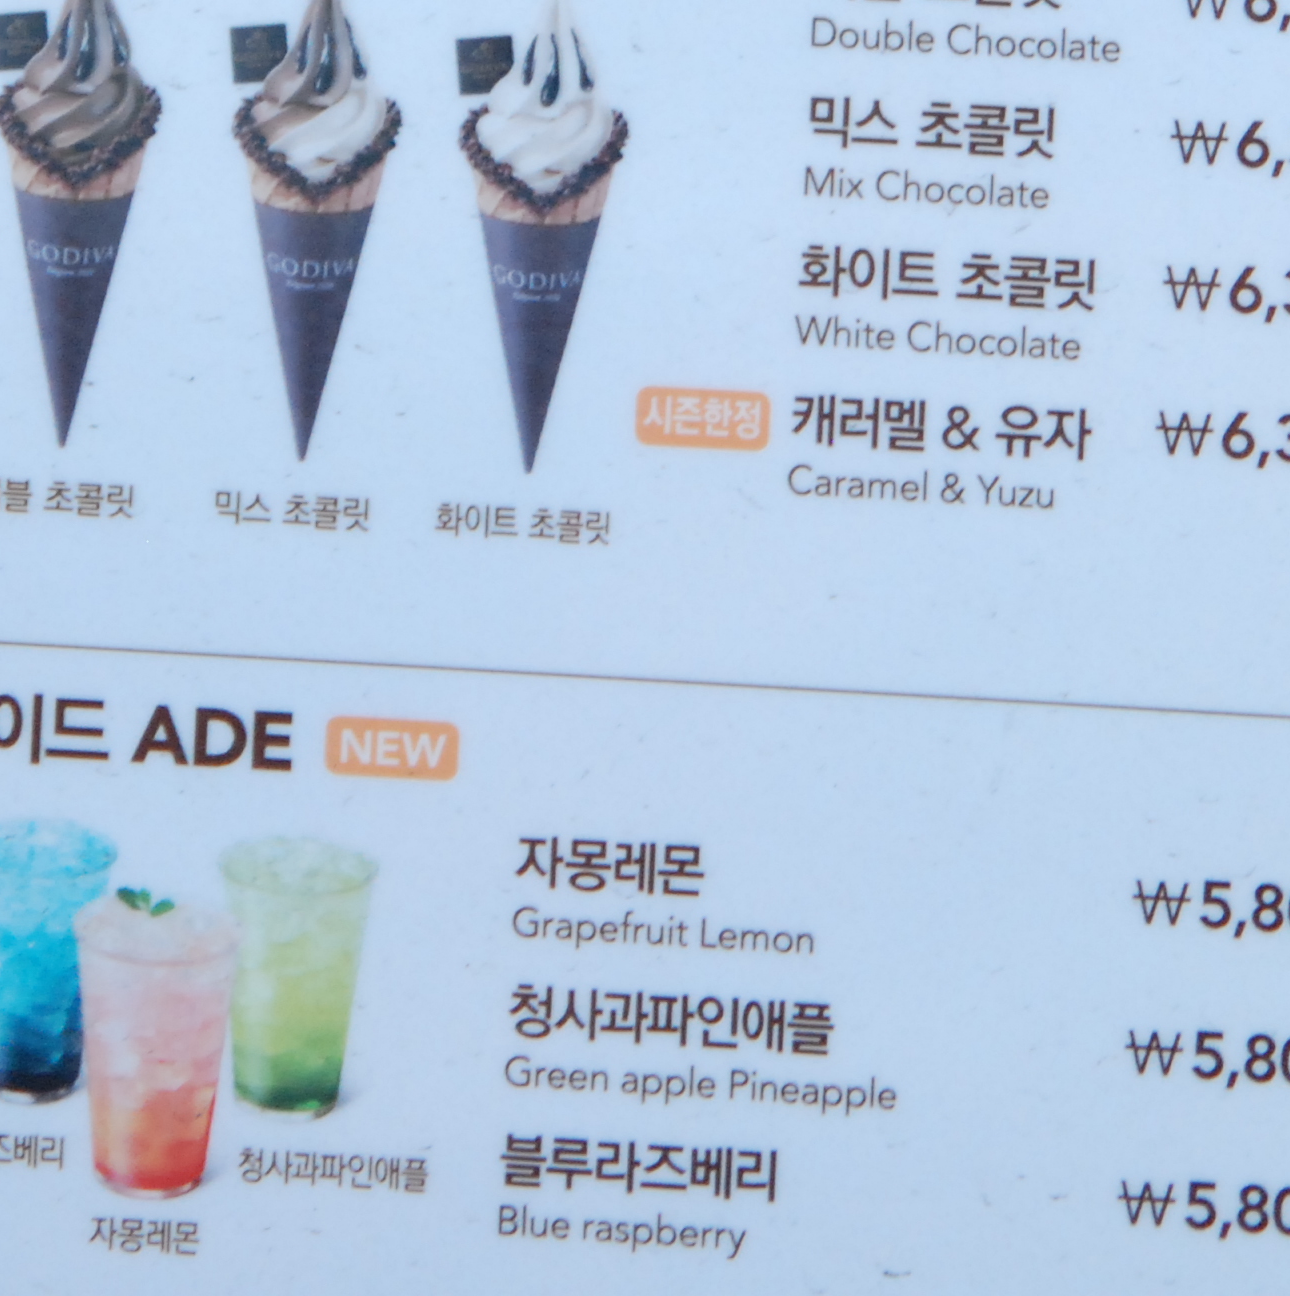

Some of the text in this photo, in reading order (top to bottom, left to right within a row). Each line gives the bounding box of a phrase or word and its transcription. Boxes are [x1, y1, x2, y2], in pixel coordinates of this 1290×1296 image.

[811, 17, 1121, 64] Double Chocolate
[809, 96, 898, 147] 믹스
[915, 101, 1056, 160] 초콜릿
[803, 167, 1050, 210] Mix Chocolate
[799, 244, 939, 300] 화이트
[956, 252, 1097, 311] 초콜릿
[795, 314, 1081, 361] White Chocolate
[642, 394, 762, 439] 시즌한정
[792, 394, 927, 450] 캐러멜
[941, 406, 979, 451] &
[995, 405, 1091, 461] 유자
[43, 479, 134, 518] 초콜릿
[215, 490, 370, 532] 믹스 초콜릿
[787, 465, 1055, 510] Caramel & Yuzu
[436, 502, 610, 545] 화이트 초콜릿
[131, 705, 293, 771] ADE
[340, 728, 447, 768] NEW
[516, 837, 704, 896] 자몽레몬
[512, 907, 814, 954] Grapefruit Lemon
[509, 983, 835, 1055] 청사과파인애플
[505, 1056, 897, 1111] Green apple Pineapple
[238, 1147, 429, 1193] 청사과파인애플
[500, 1133, 778, 1202] 블루라즈베리
[90, 1216, 199, 1255] 자몽레몬
[497, 1204, 747, 1259] Blue raspberry
